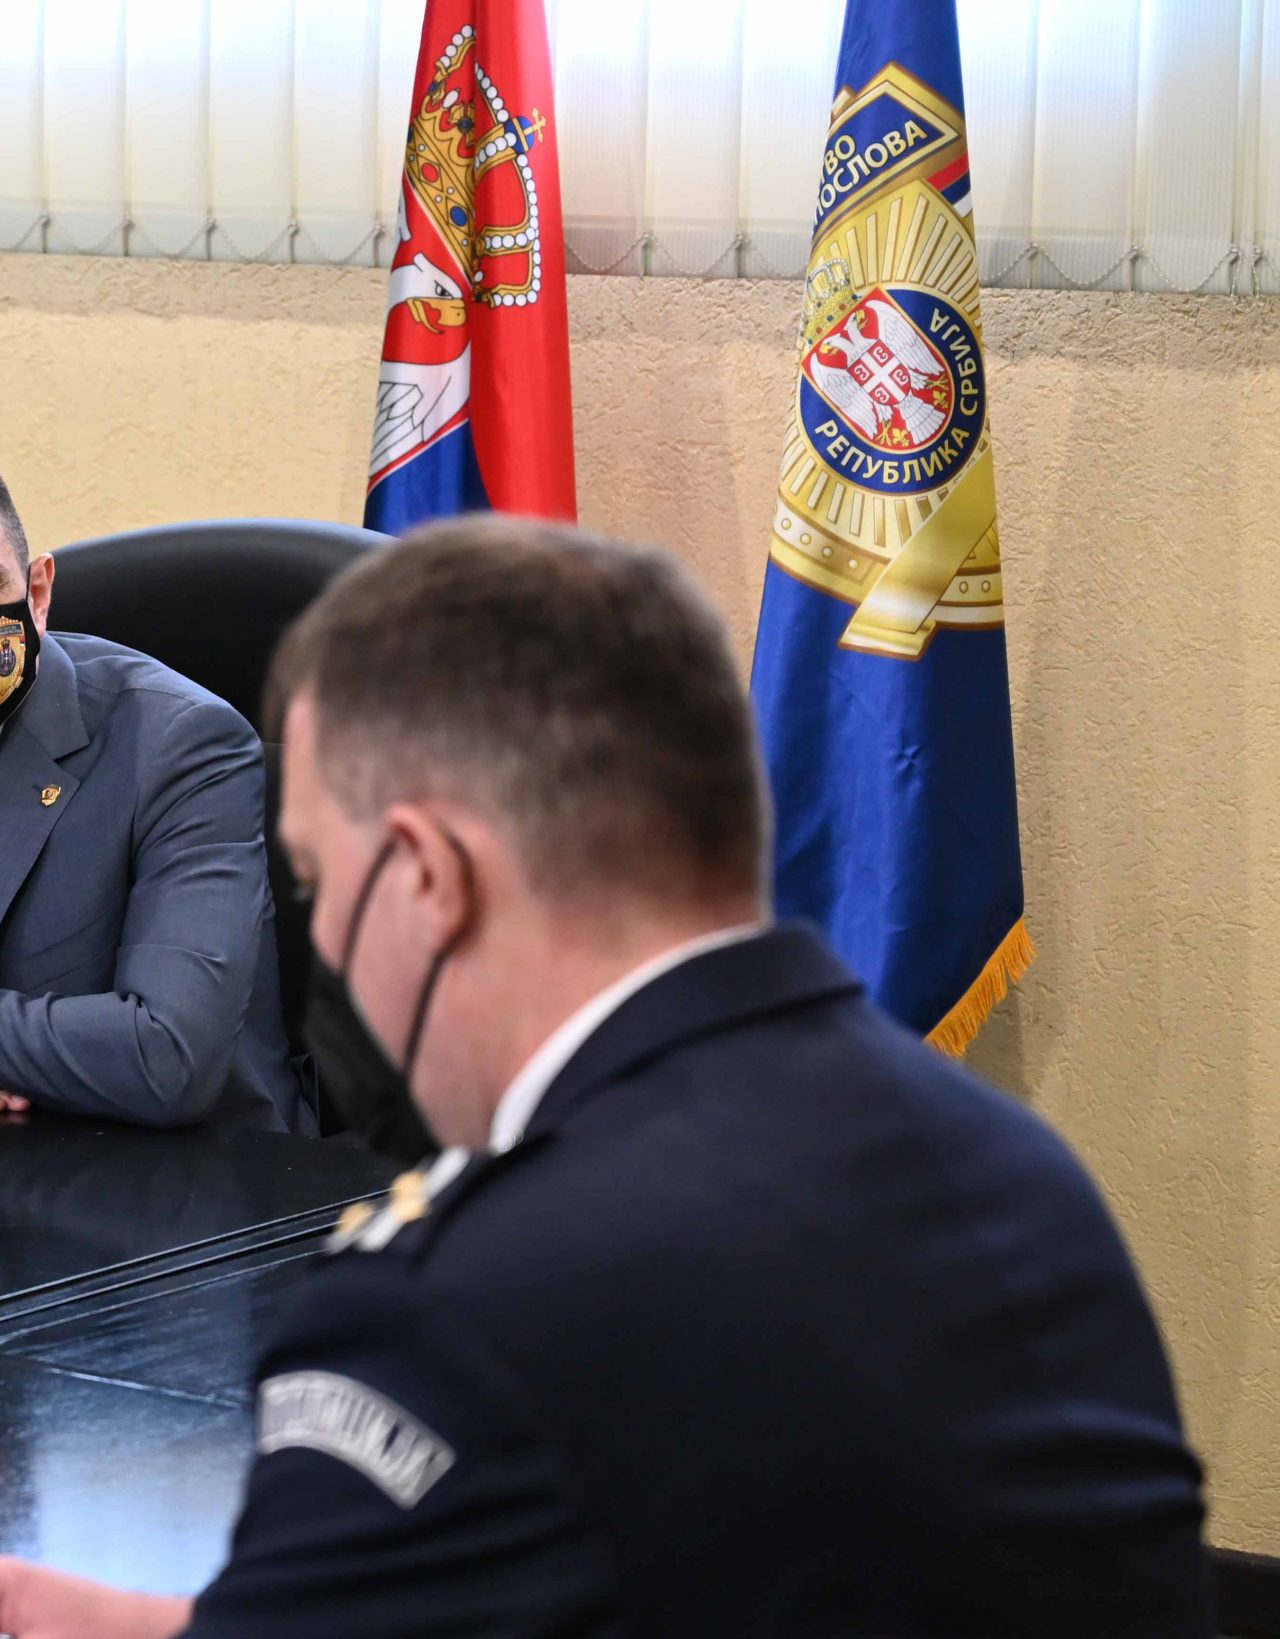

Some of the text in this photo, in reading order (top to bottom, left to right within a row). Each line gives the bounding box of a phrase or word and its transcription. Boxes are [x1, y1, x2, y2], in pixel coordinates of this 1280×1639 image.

[821, 135, 856, 184] ВО
[814, 308, 979, 484] РЕПУБЛИКА СРБИЈА
